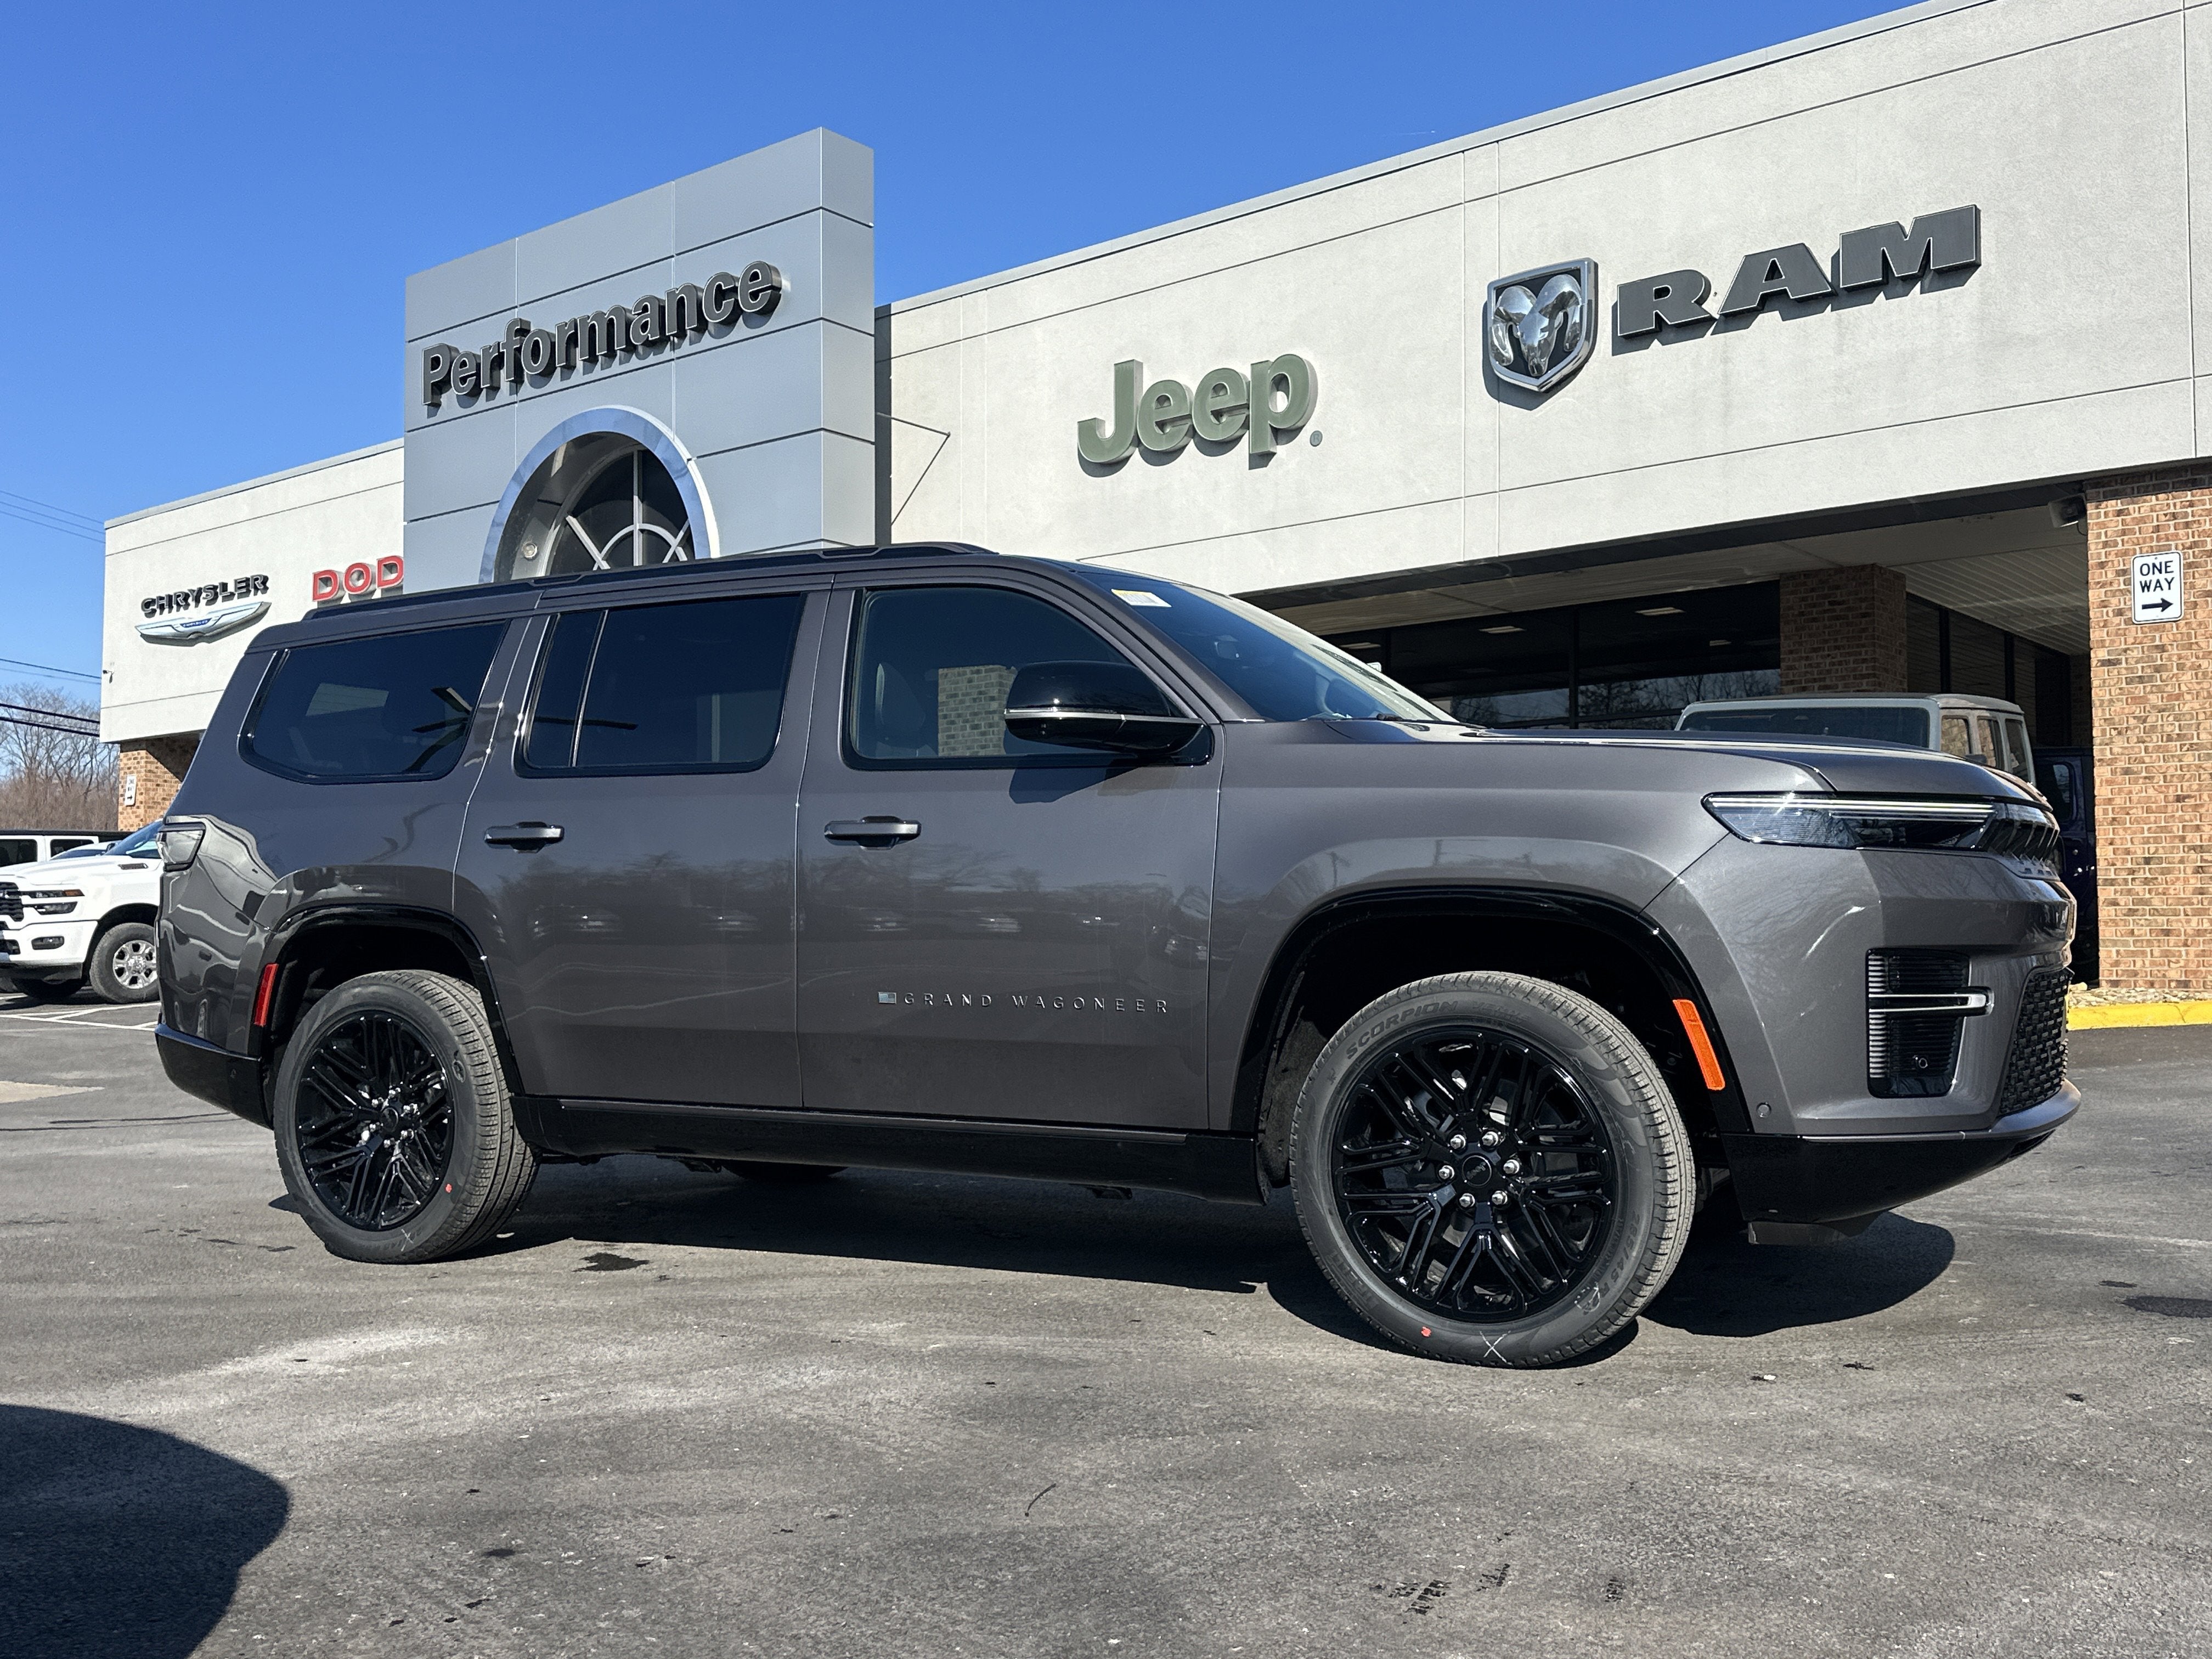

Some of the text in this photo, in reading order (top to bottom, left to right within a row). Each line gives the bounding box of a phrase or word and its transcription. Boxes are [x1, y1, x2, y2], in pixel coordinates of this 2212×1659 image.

[1617, 204, 1980, 336] RAM
[421, 260, 781, 407] Performance
[1077, 353, 1317, 462] Jeep
[312, 555, 403, 602] DOD
[2139, 577, 2175, 593] WAY
[2140, 560, 2174, 577] ONE
[140, 574, 268, 616] CHRYSLER
[904, 992, 1167, 1013] GRAND WAGONEER
[1346, 1000, 1458, 1060] SCORPION
